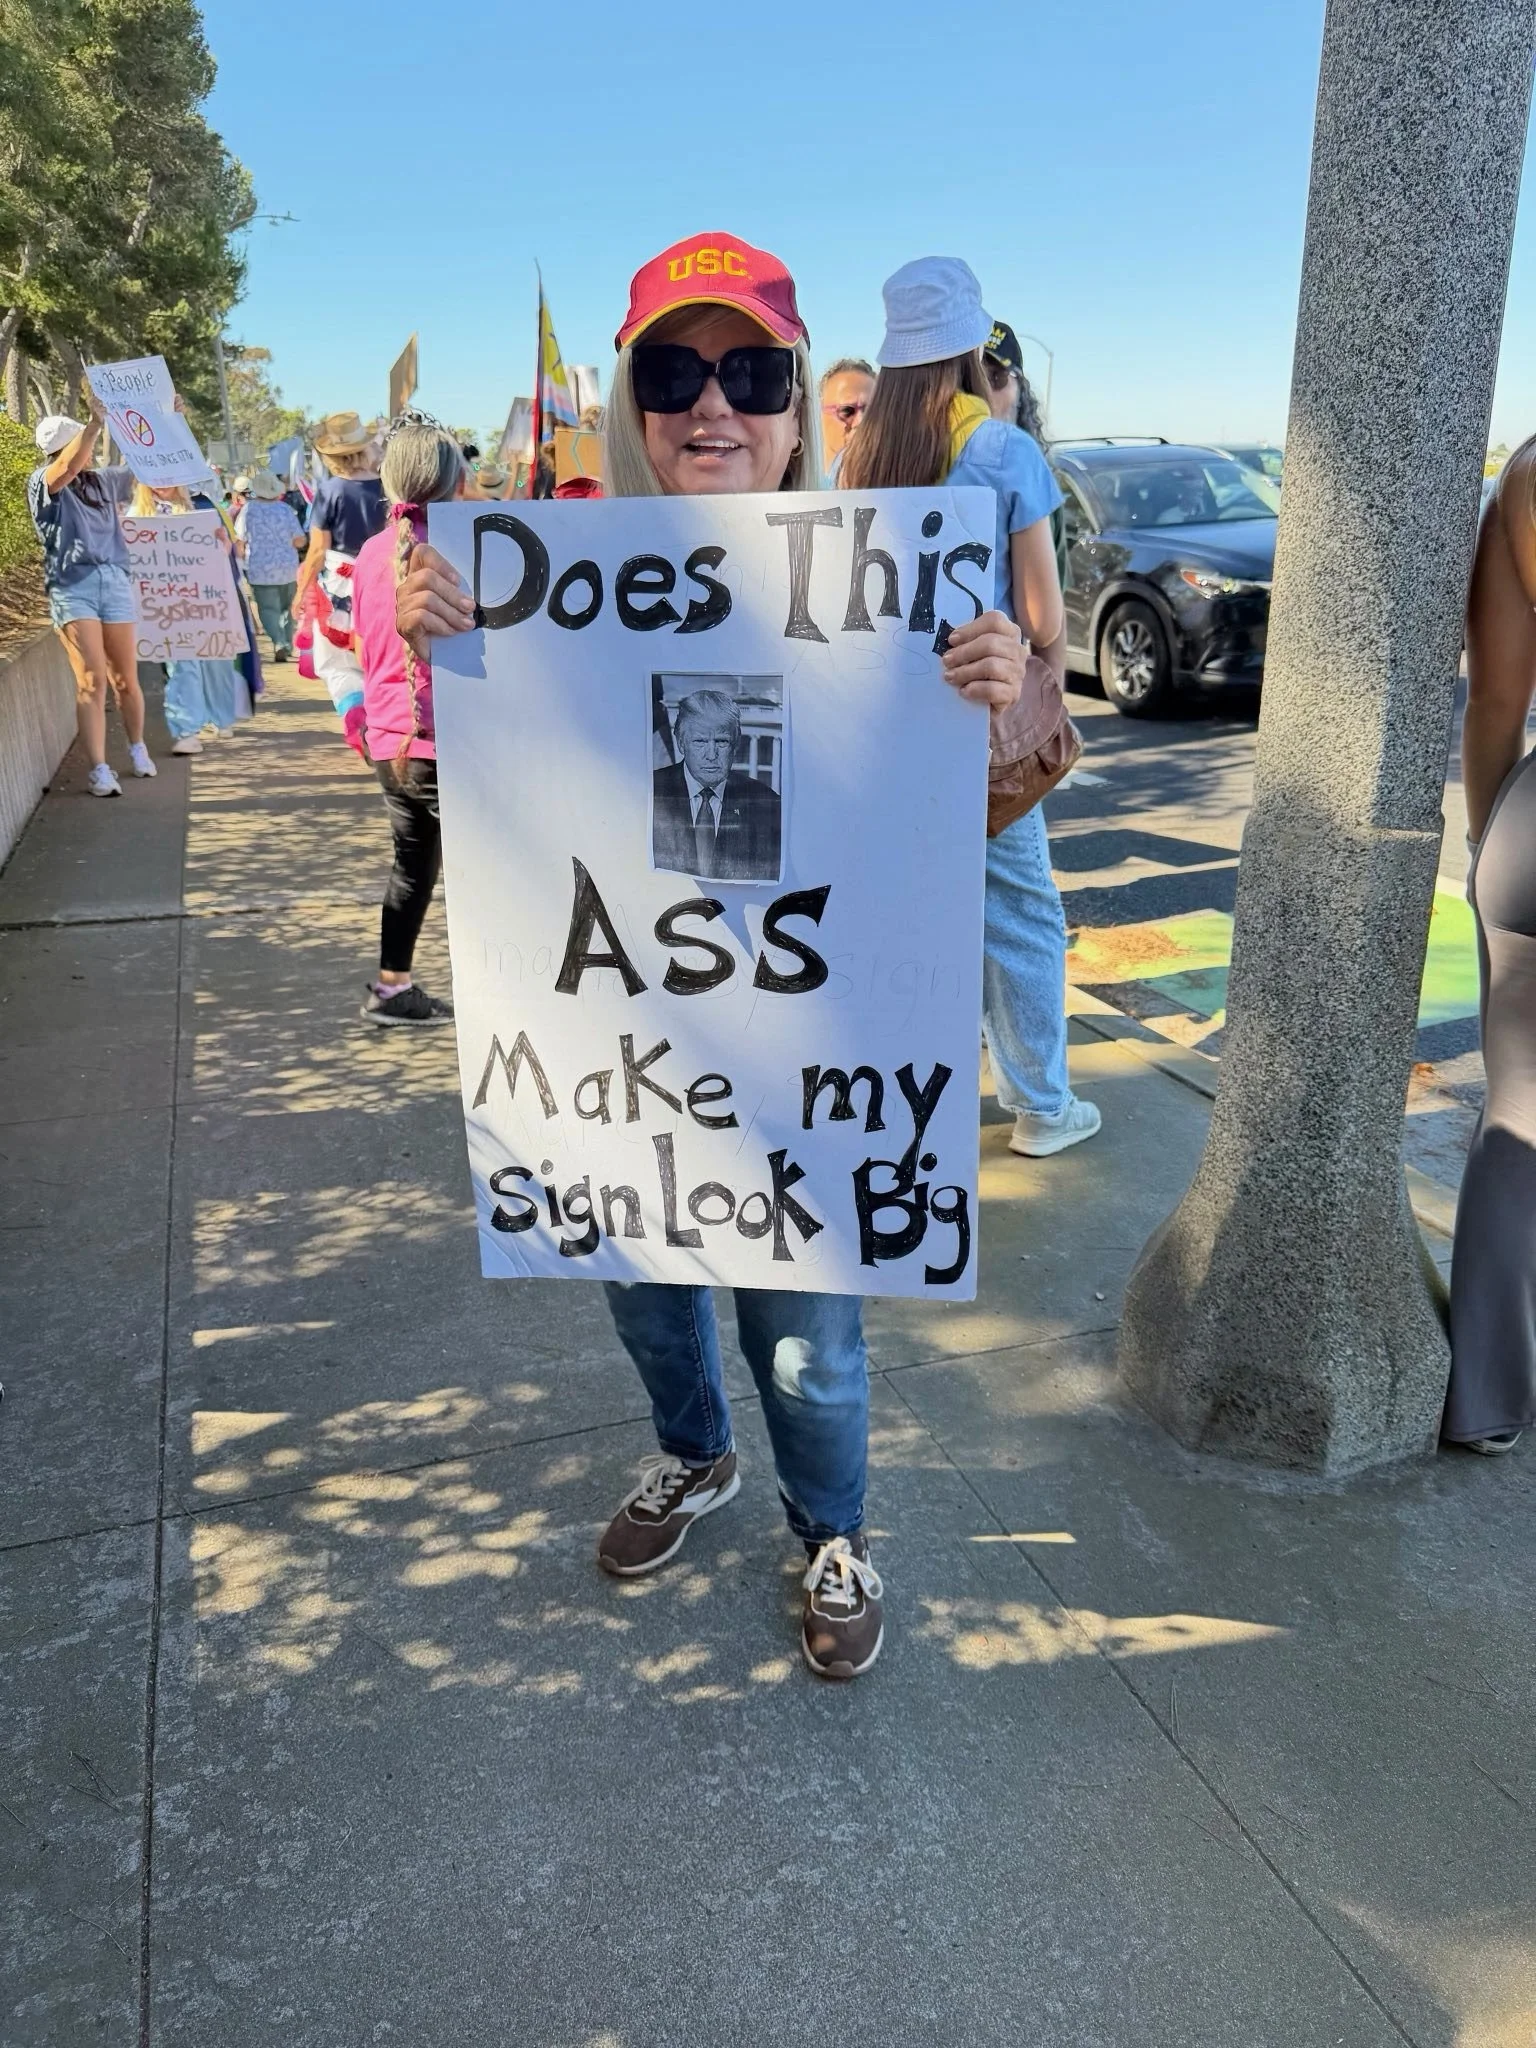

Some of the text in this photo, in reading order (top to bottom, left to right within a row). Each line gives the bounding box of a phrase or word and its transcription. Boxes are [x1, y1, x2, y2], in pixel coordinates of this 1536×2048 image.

[667, 248, 747, 282] USC
[102, 369, 157, 393] People
[121, 519, 159, 544] Sex
[163, 525, 179, 541] is
[166, 549, 206, 567] have
[157, 571, 189, 583] ever
[473, 506, 992, 656] Does This
[203, 585, 227, 600] the
[136, 636, 173, 659] Oct
[554, 856, 832, 997] ASS
[801, 1062, 954, 1183] my
[651, 1132, 825, 1263] Look
[852, 1152, 971, 1286] Big
